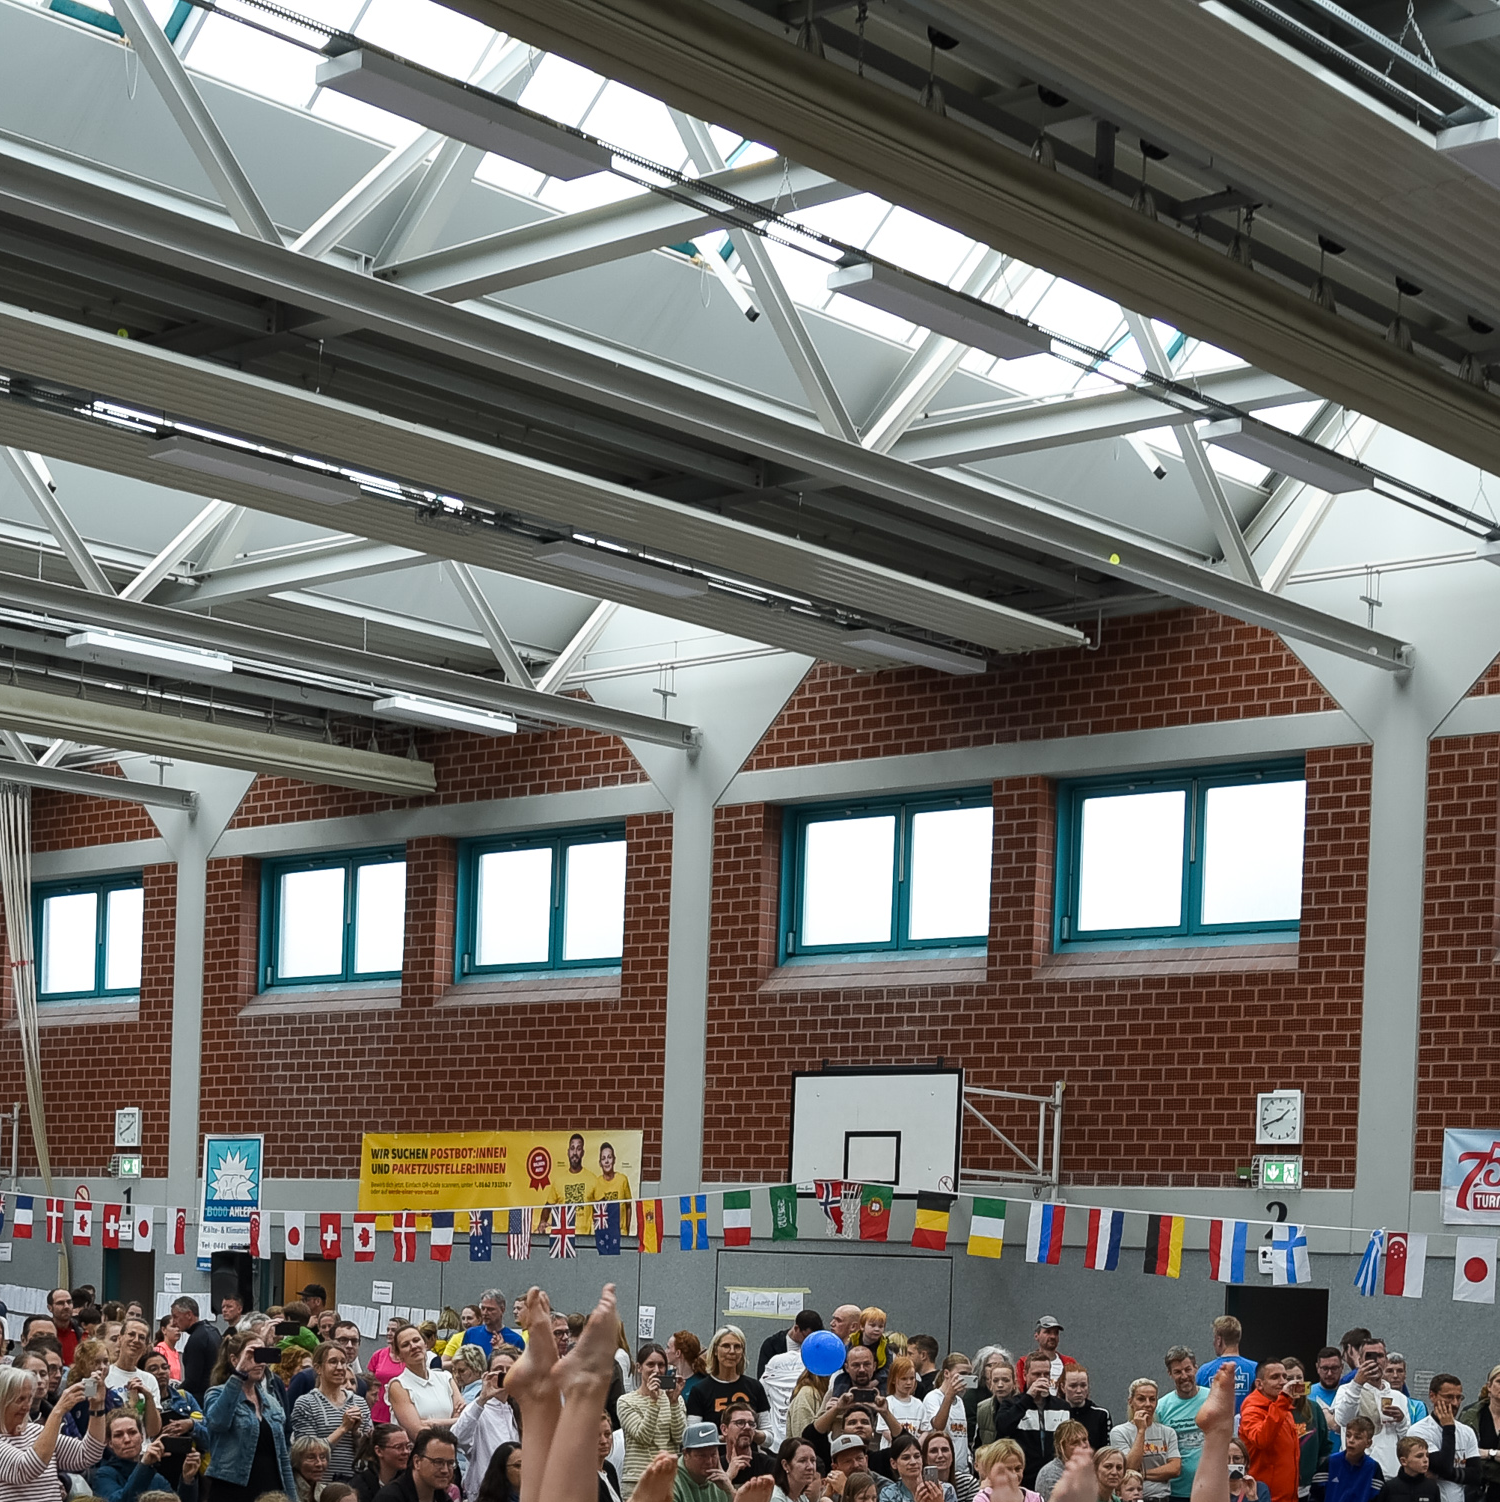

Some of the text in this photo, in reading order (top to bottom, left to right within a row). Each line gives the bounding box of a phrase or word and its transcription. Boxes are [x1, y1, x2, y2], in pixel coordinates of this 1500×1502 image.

[371, 1147, 507, 1159] WIR SUCHEN POSTBOT:INNEN
[371, 1163, 506, 1174] UND PAKETZUSTELLER:INNEN
[123, 1186, 132, 1215] 1
[206, 1205, 228, 1217] BODO
[1264, 1201, 1288, 1240] 2
